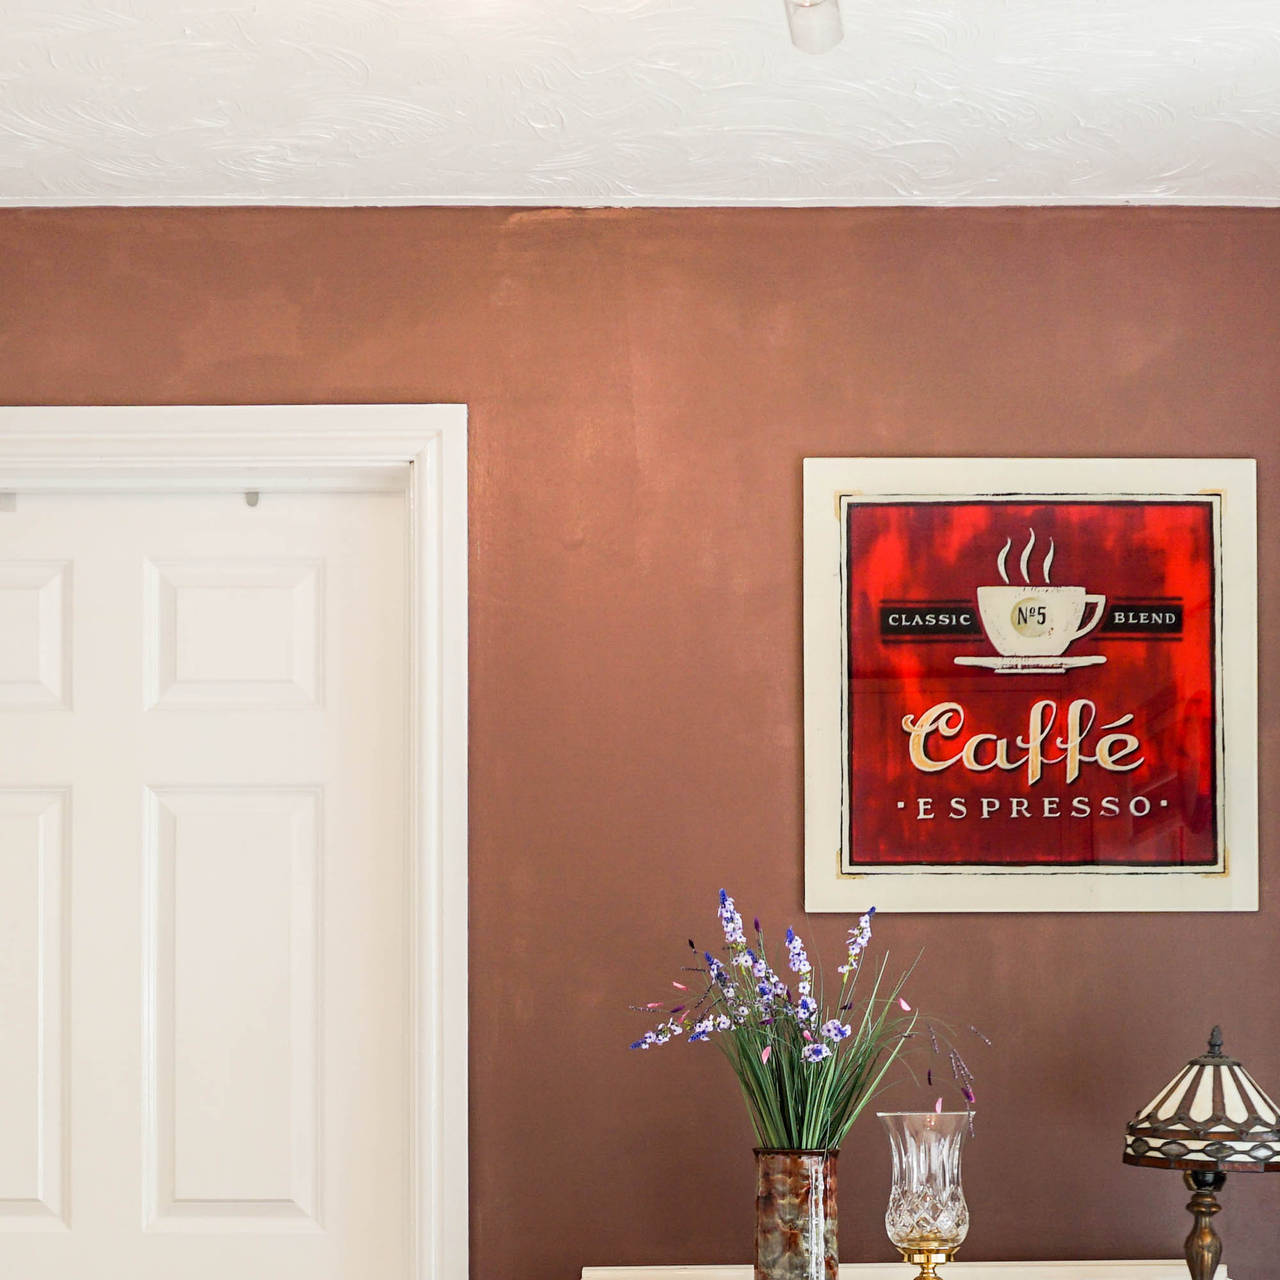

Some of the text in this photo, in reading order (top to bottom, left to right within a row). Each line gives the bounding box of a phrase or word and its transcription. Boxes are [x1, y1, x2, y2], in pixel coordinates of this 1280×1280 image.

[888, 613, 971, 626] CLASSIC
[1113, 611, 1177, 624] BLEND
[902, 699, 1144, 785] Caffé
[917, 796, 1151, 820] ESPRESSO
